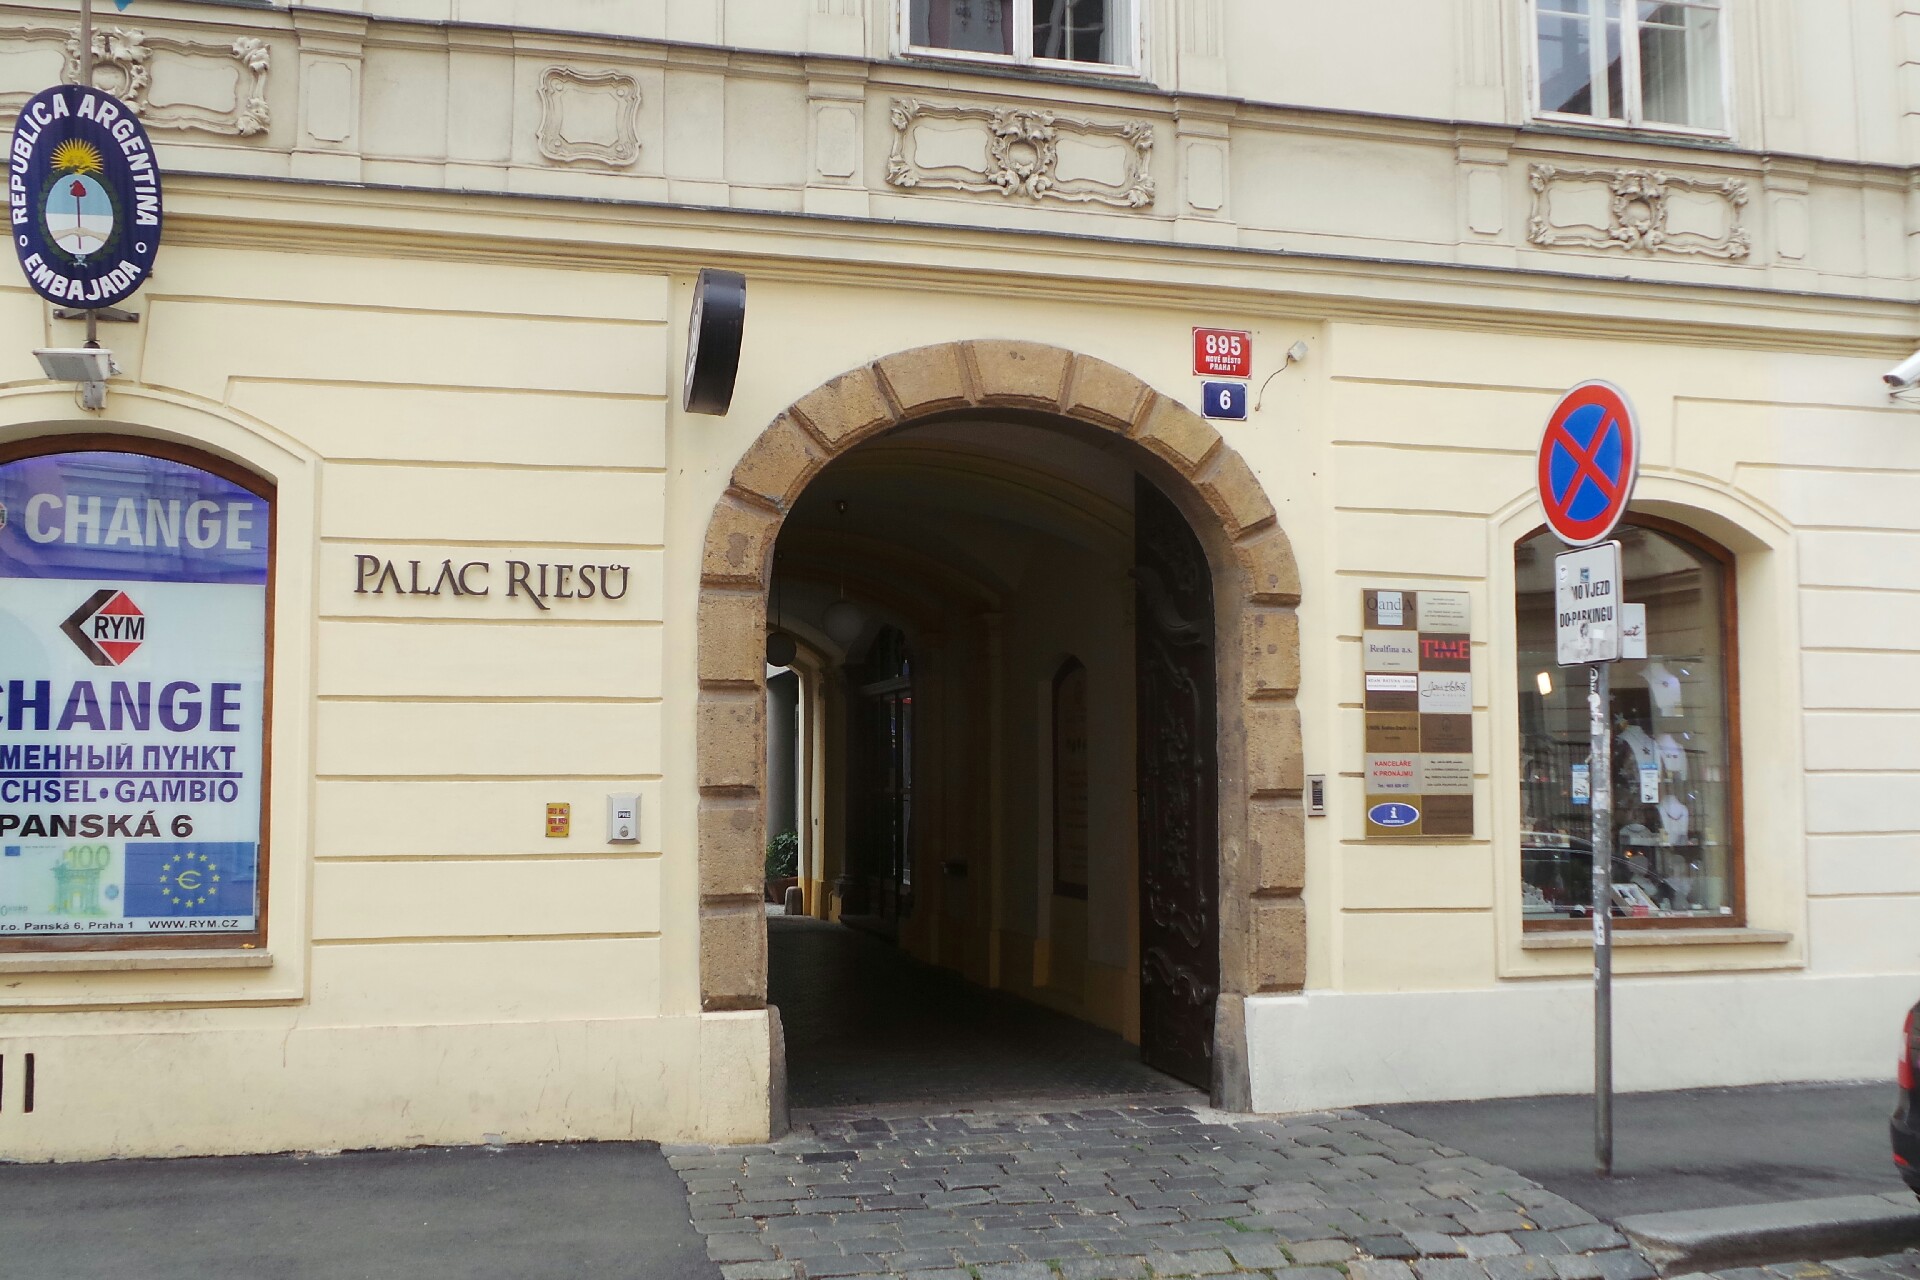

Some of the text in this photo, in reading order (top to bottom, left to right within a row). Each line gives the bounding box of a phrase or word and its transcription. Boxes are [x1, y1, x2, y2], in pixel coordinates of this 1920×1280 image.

[11, 93, 158, 226] REPUBLICA ARGENTINA
[24, 253, 141, 301] EMBAJADA
[1205, 334, 1241, 356] 895
[1205, 355, 1221, 363] NOVÉ
[1209, 362, 1231, 371] PRAHA
[1219, 389, 1231, 410] 6
[24, 493, 253, 550] CHANGE
[353, 554, 490, 596] PALÁC
[94, 615, 145, 641] RYM
[0, 680, 242, 732] HANGE
[143, 745, 236, 770] ПУНКТ
[115, 780, 239, 803] GAMBIO
[0, 810, 193, 838] PANSKÁ 6
[69, 845, 111, 869] 100
[24, 921, 70, 931] Panská
[74, 922, 84, 931] 6,
[89, 921, 124, 930] Praha
[149, 919, 239, 929] WWW.RYM.CZ
